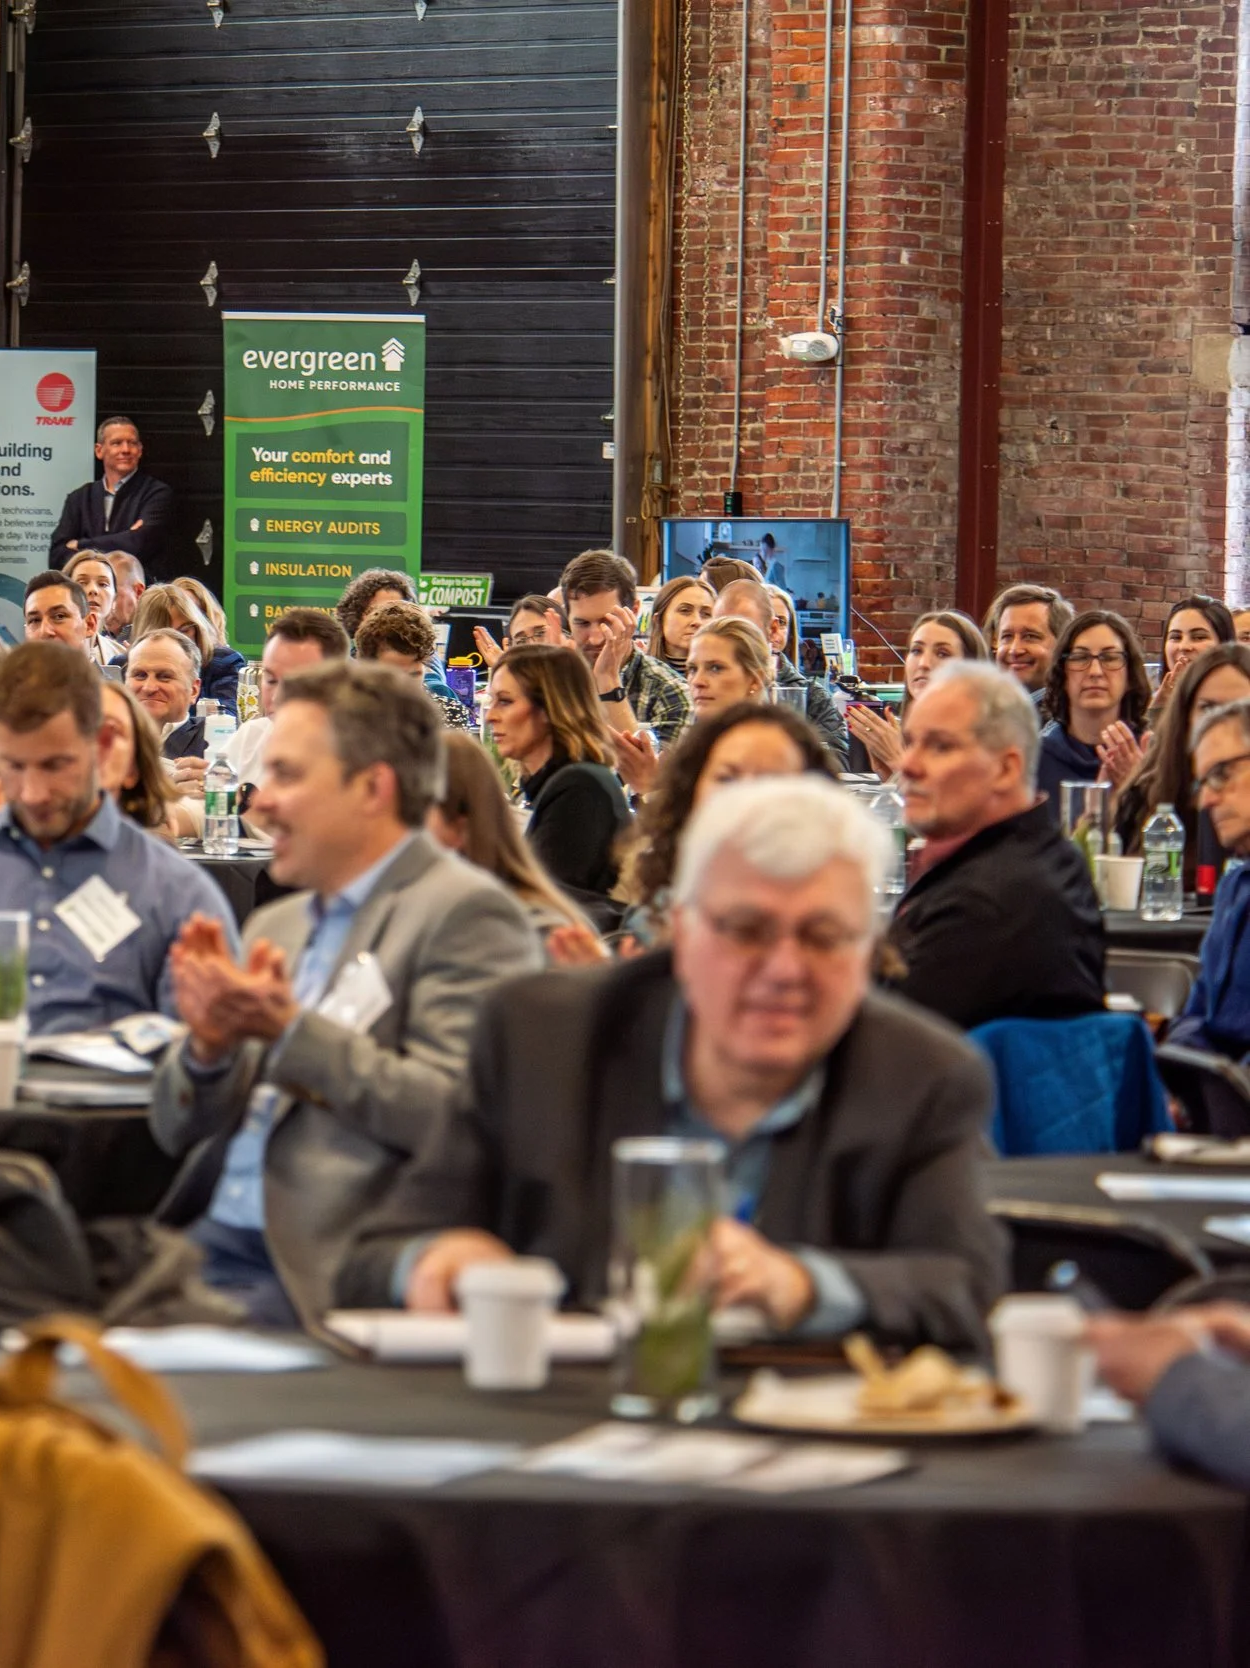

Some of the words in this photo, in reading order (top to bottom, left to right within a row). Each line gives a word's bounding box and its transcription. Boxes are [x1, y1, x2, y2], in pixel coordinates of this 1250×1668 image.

[242, 349, 376, 376] evergreen
[269, 379, 305, 390] HOME
[309, 380, 401, 392] PERFORMANCE
[35, 416, 76, 426] TRANE
[251, 447, 288, 463] Your
[291, 449, 356, 464] comfort
[358, 450, 391, 465] and
[250, 468, 327, 487] efficiency
[331, 472, 393, 488] experts
[265, 519, 323, 534] ENERGY
[327, 522, 382, 535] AUDITS
[265, 563, 352, 577] INSULATION
[428, 587, 486, 606] COMPOST
